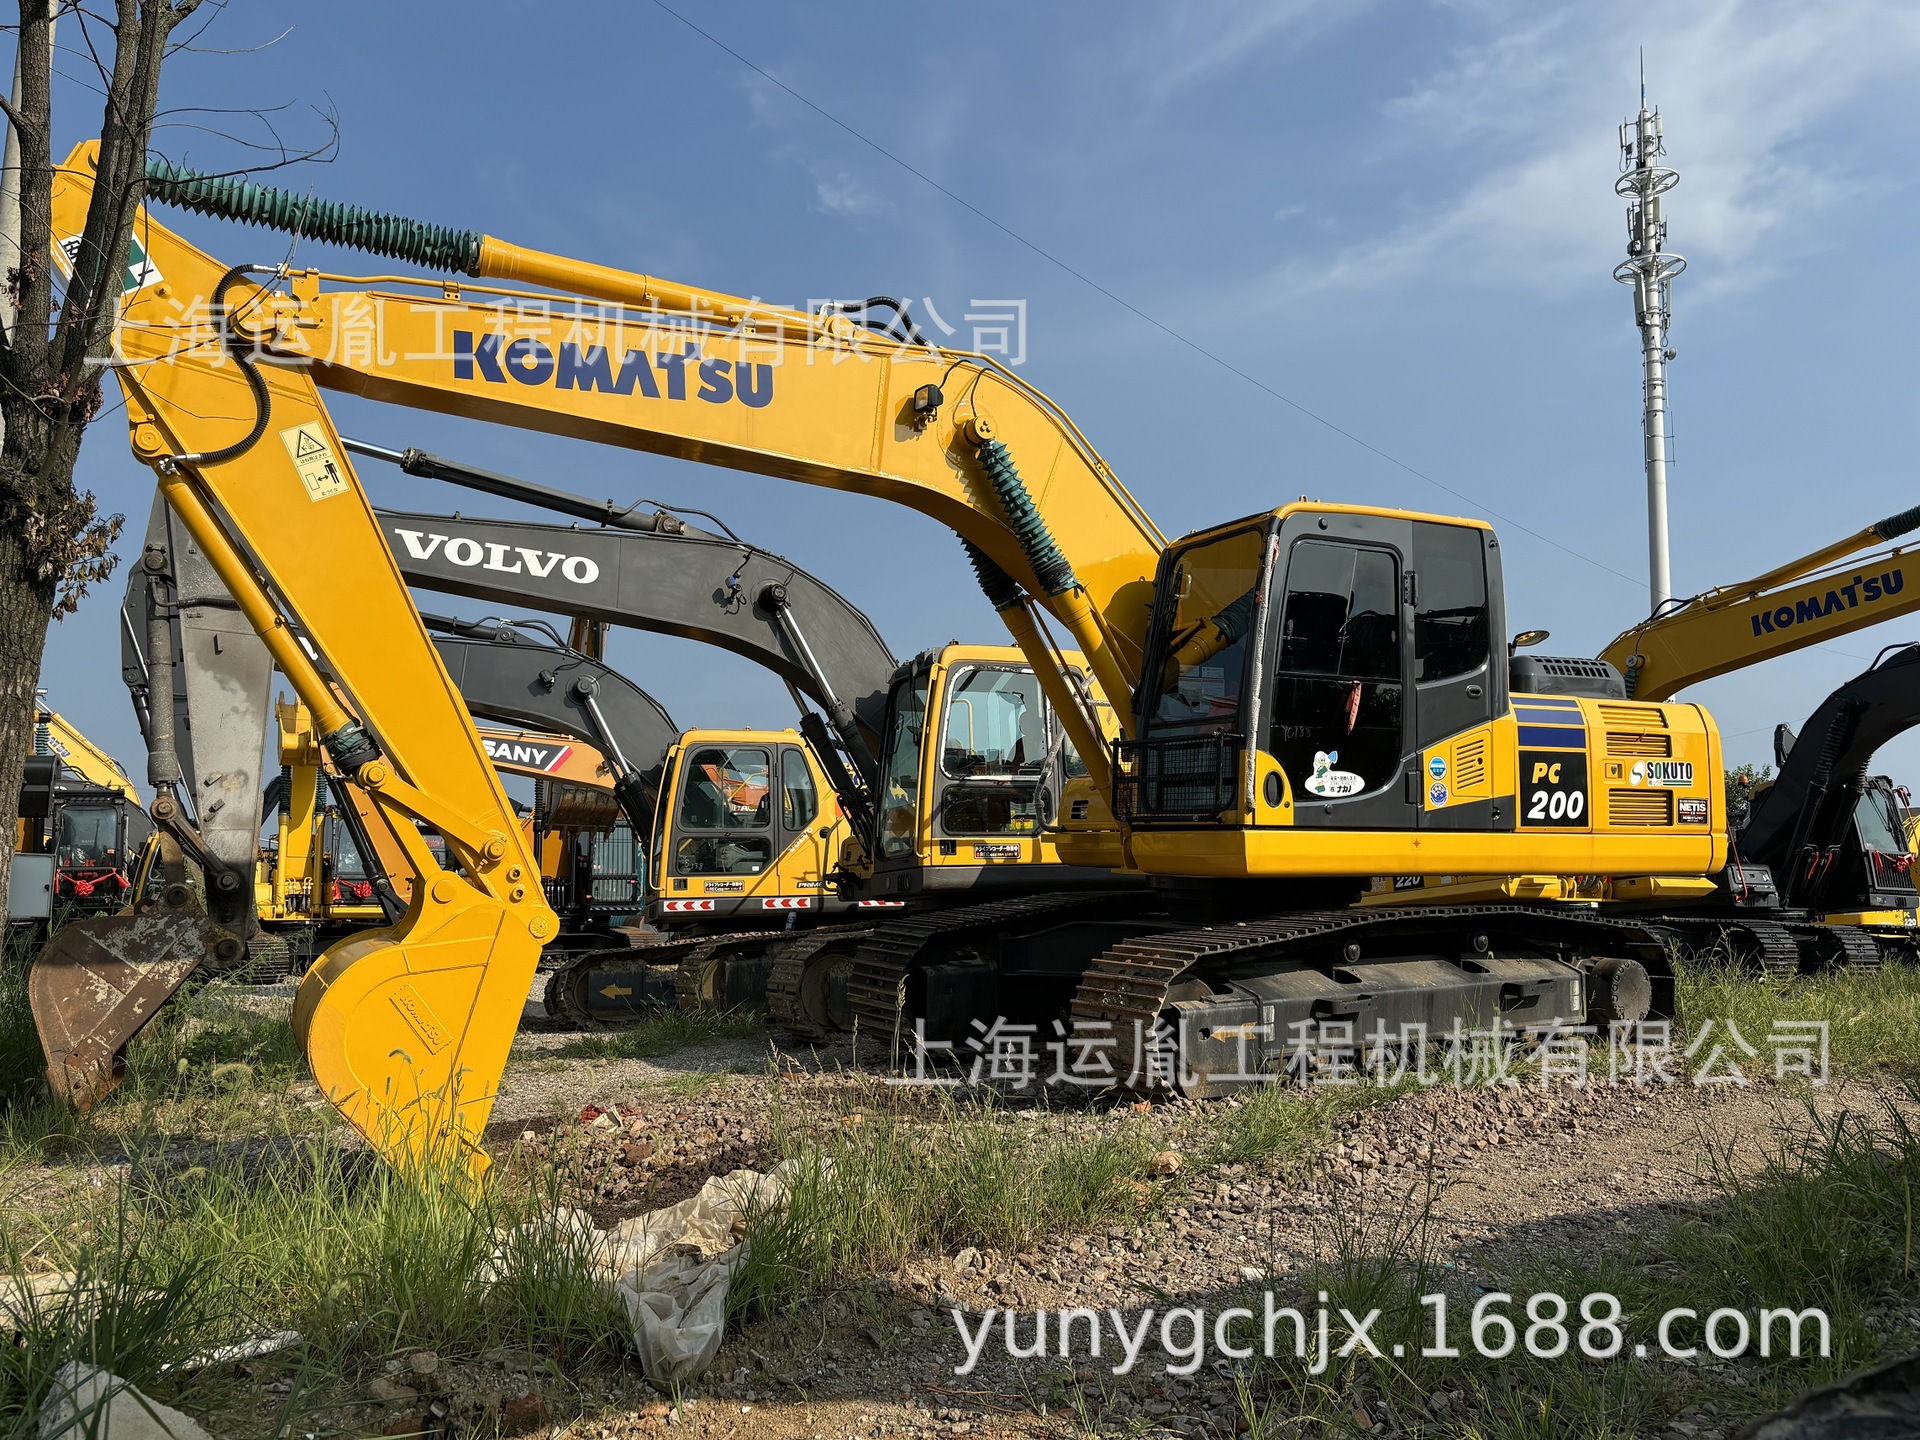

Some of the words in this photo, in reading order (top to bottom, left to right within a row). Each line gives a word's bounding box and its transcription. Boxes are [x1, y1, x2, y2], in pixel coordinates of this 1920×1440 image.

[453, 329, 774, 409] KOMATSU
[394, 528, 600, 584] VOLVO
[1751, 568, 1904, 637] KOMATSU
[481, 739, 549, 765] SANY
[1531, 762, 1562, 784] PC
[1647, 761, 1693, 780] SOKUTO
[1527, 790, 1584, 820] 200
[1679, 802, 1707, 812] NETIS
